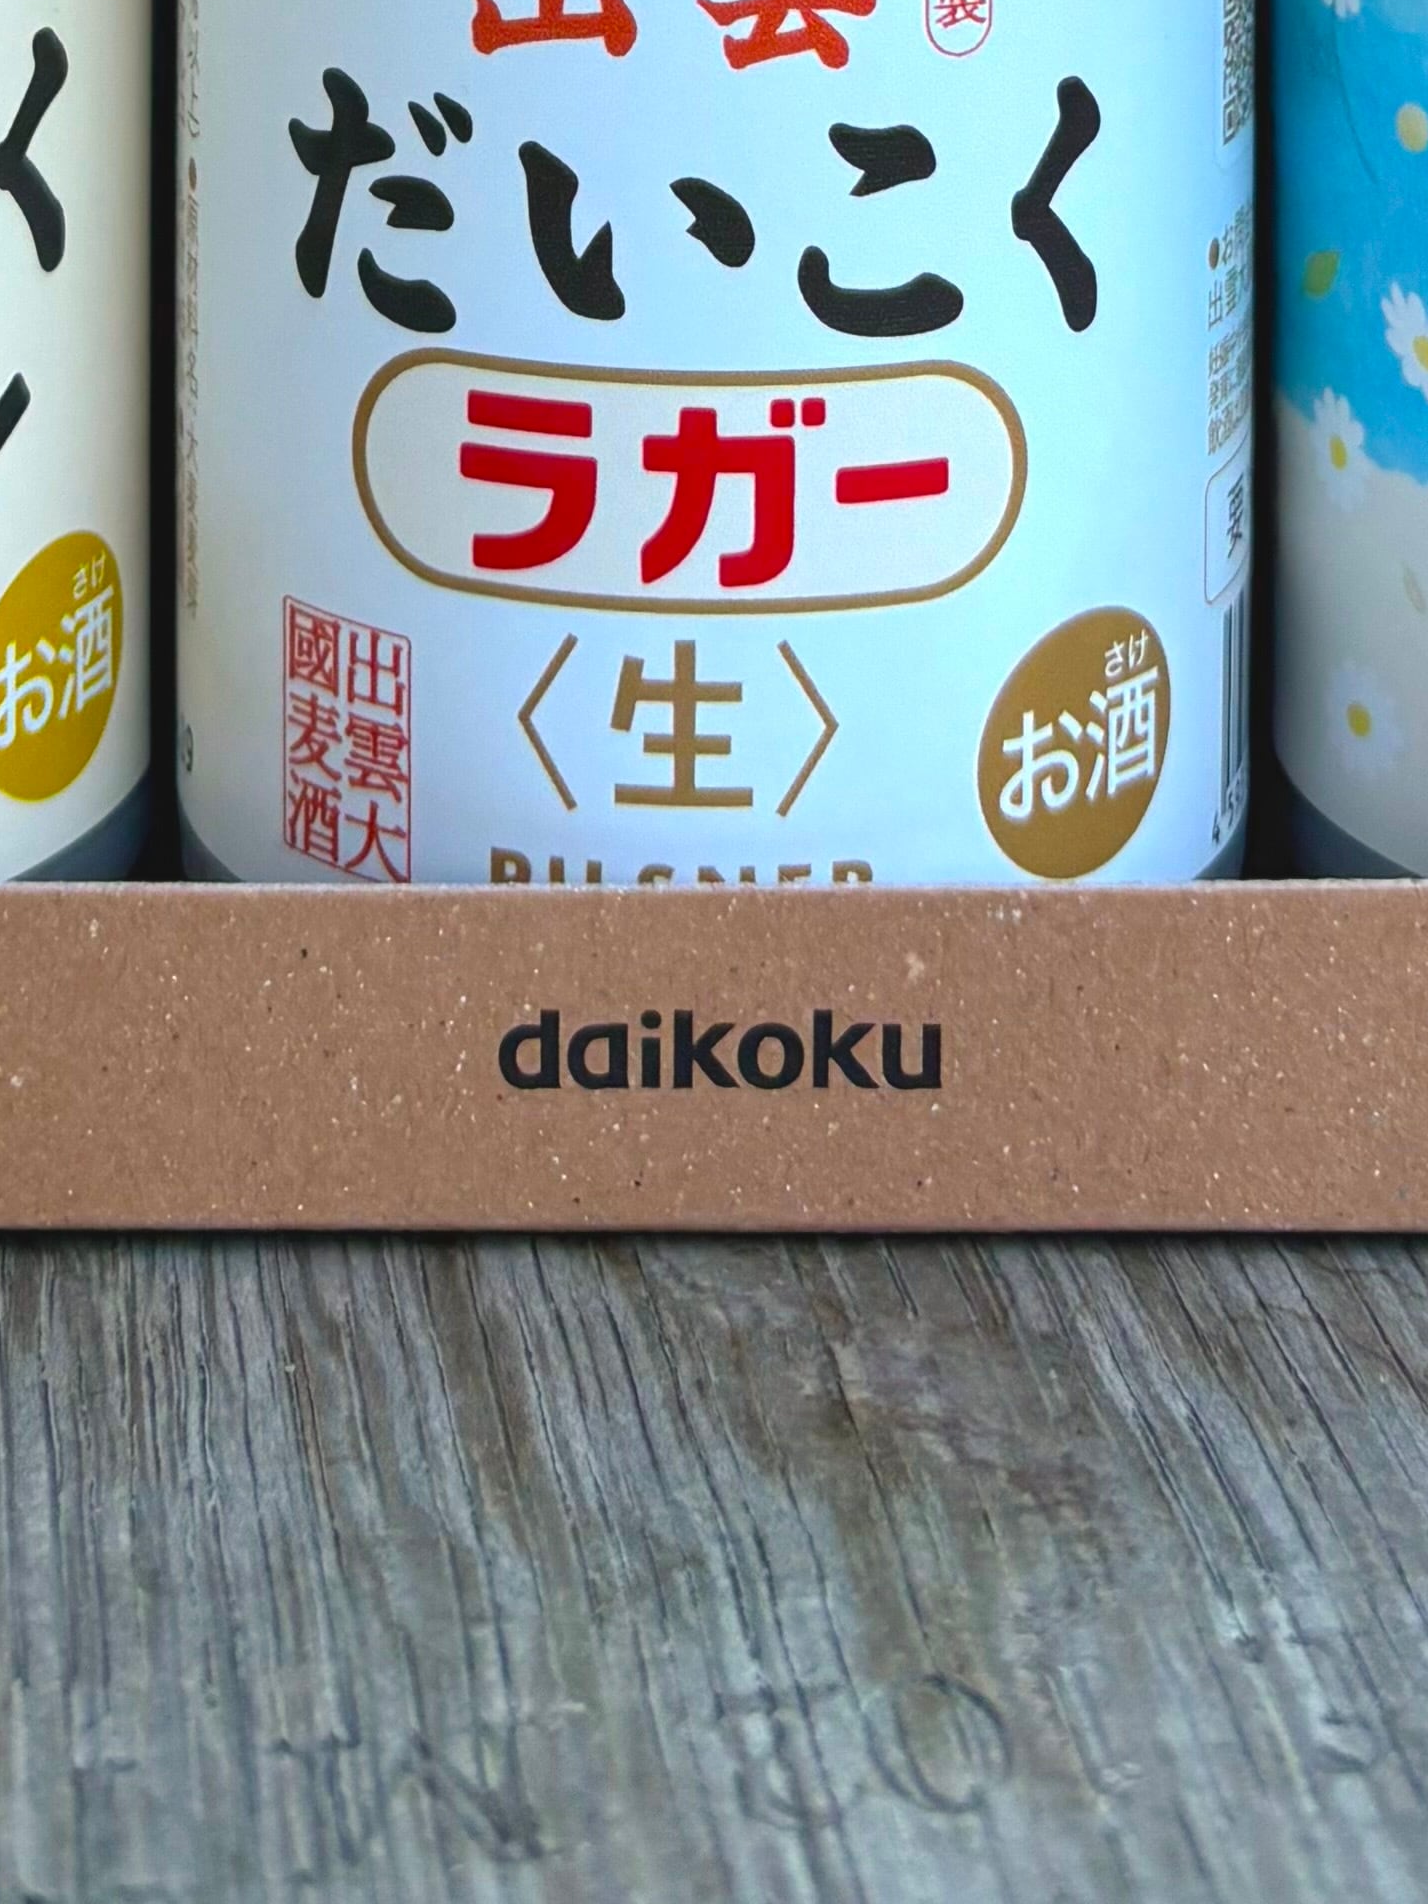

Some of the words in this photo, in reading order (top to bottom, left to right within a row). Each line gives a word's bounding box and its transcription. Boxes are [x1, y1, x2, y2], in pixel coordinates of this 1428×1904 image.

[287, 67, 1100, 336] だいこく
[459, 387, 950, 591] ラガー
[72, 550, 106, 600] さけ
[1104, 629, 1149, 677] さけ
[999, 665, 1159, 820] お酒
[498, 1008, 942, 1090] daikoku
